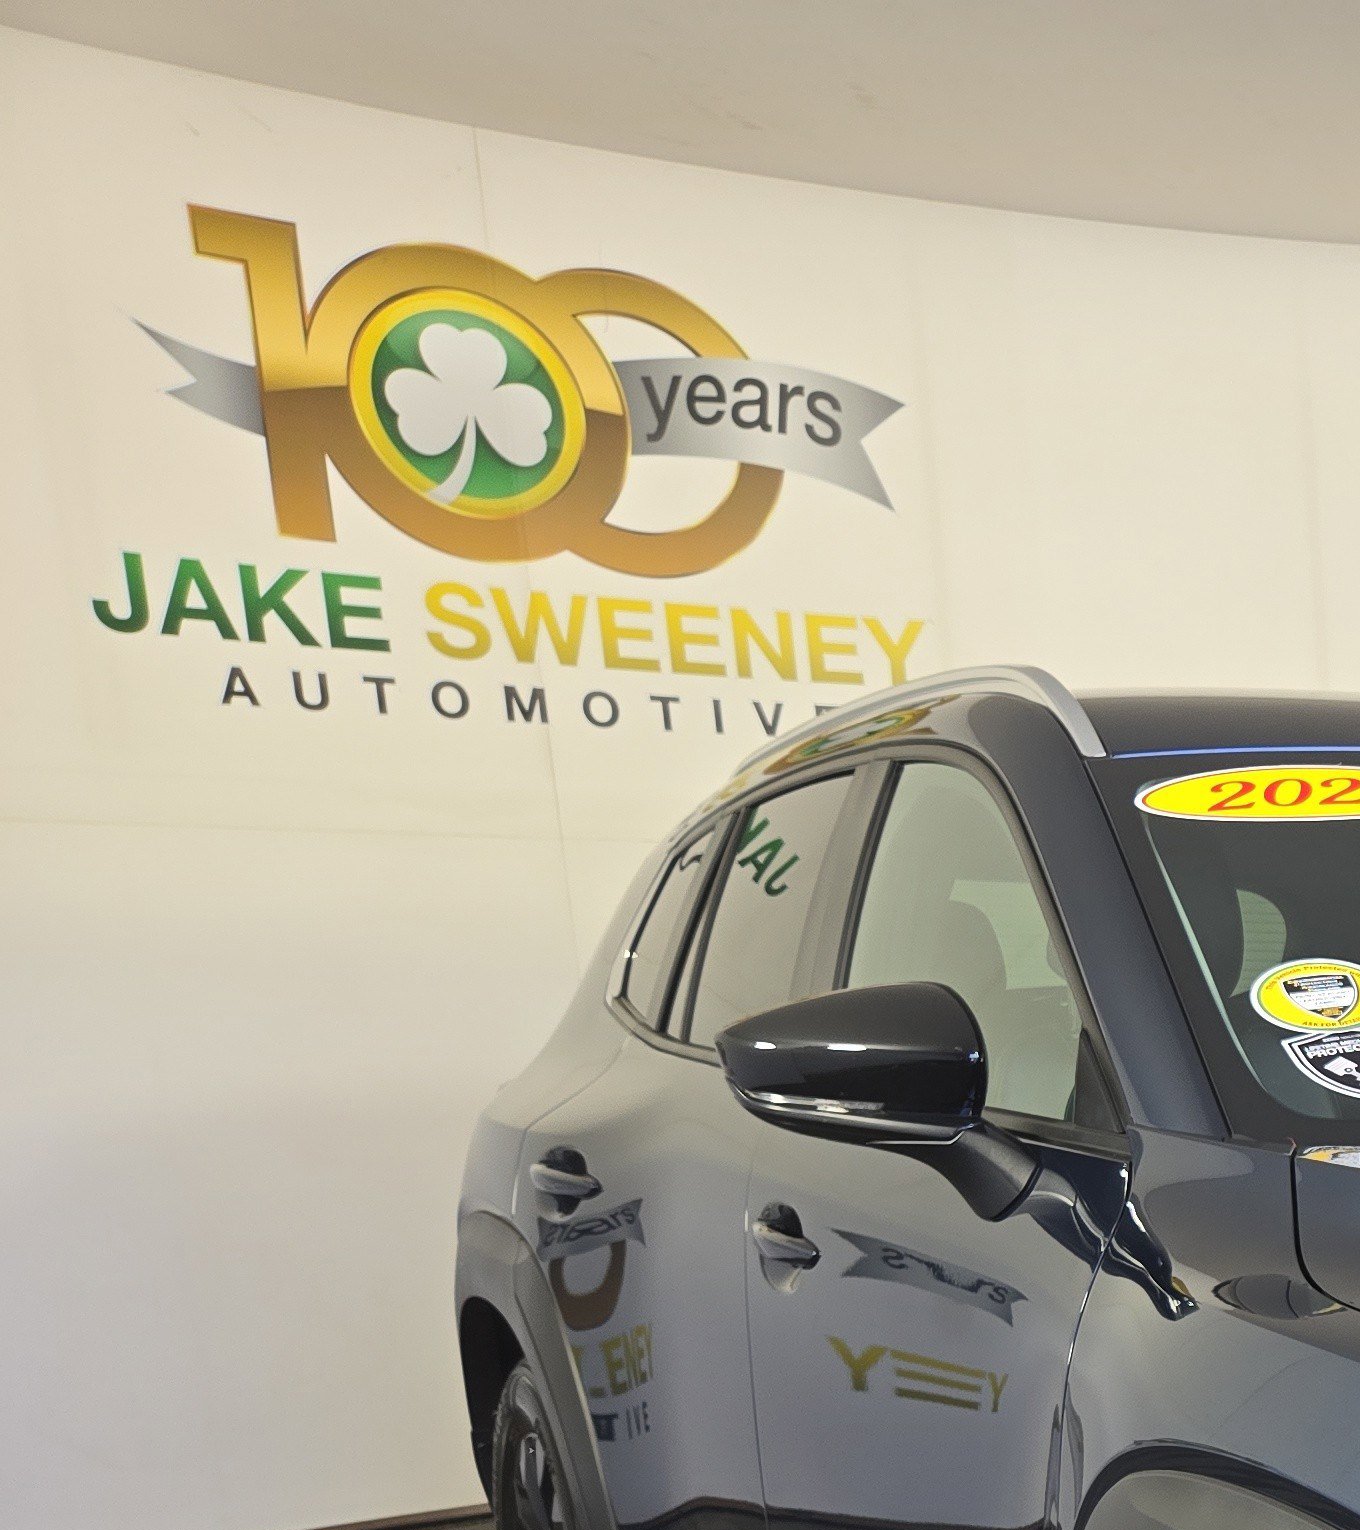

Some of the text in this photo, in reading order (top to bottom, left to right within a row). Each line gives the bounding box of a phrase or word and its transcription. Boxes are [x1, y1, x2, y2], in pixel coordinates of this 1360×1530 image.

[641, 370, 844, 447] years
[92, 550, 926, 686] JAKE SWEENEY
[221, 667, 843, 737] AUTOMOTIV
